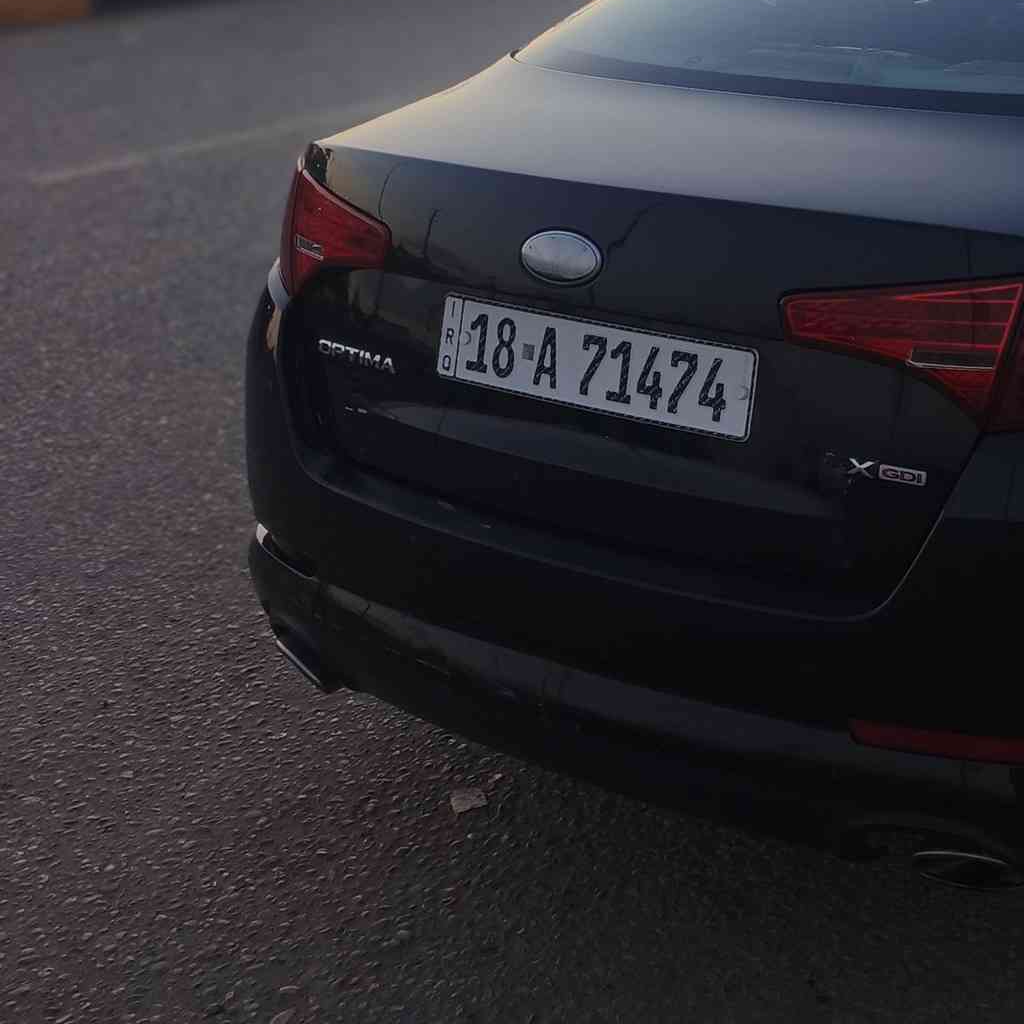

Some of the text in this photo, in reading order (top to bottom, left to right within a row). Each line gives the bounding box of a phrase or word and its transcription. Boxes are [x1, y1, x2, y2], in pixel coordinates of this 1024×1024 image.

[318, 338, 396, 374] OPTIMA
[465, 313, 727, 422] 18 A 71474
